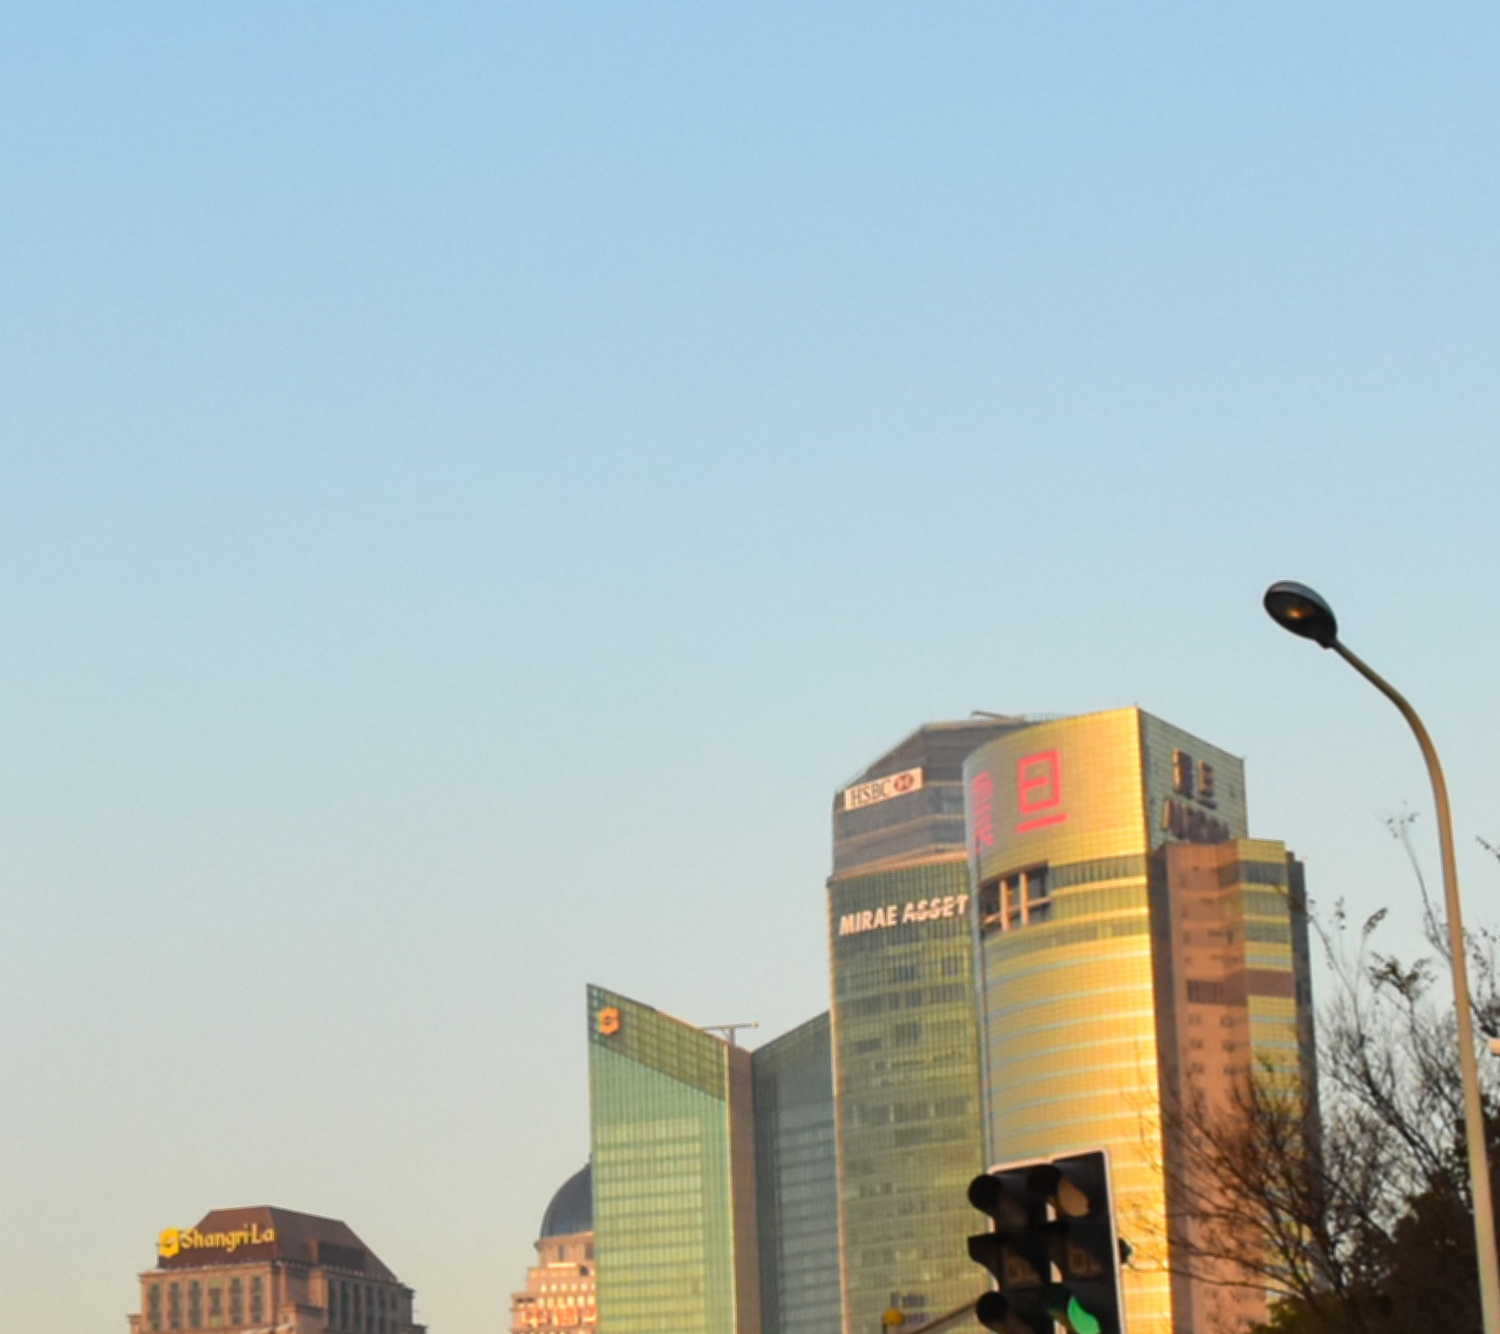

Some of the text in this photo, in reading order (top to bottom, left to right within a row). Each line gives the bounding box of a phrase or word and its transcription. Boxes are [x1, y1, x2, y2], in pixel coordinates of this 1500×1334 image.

[850, 778, 892, 807] HSBC
[839, 894, 970, 937] MIRAE ASSET
